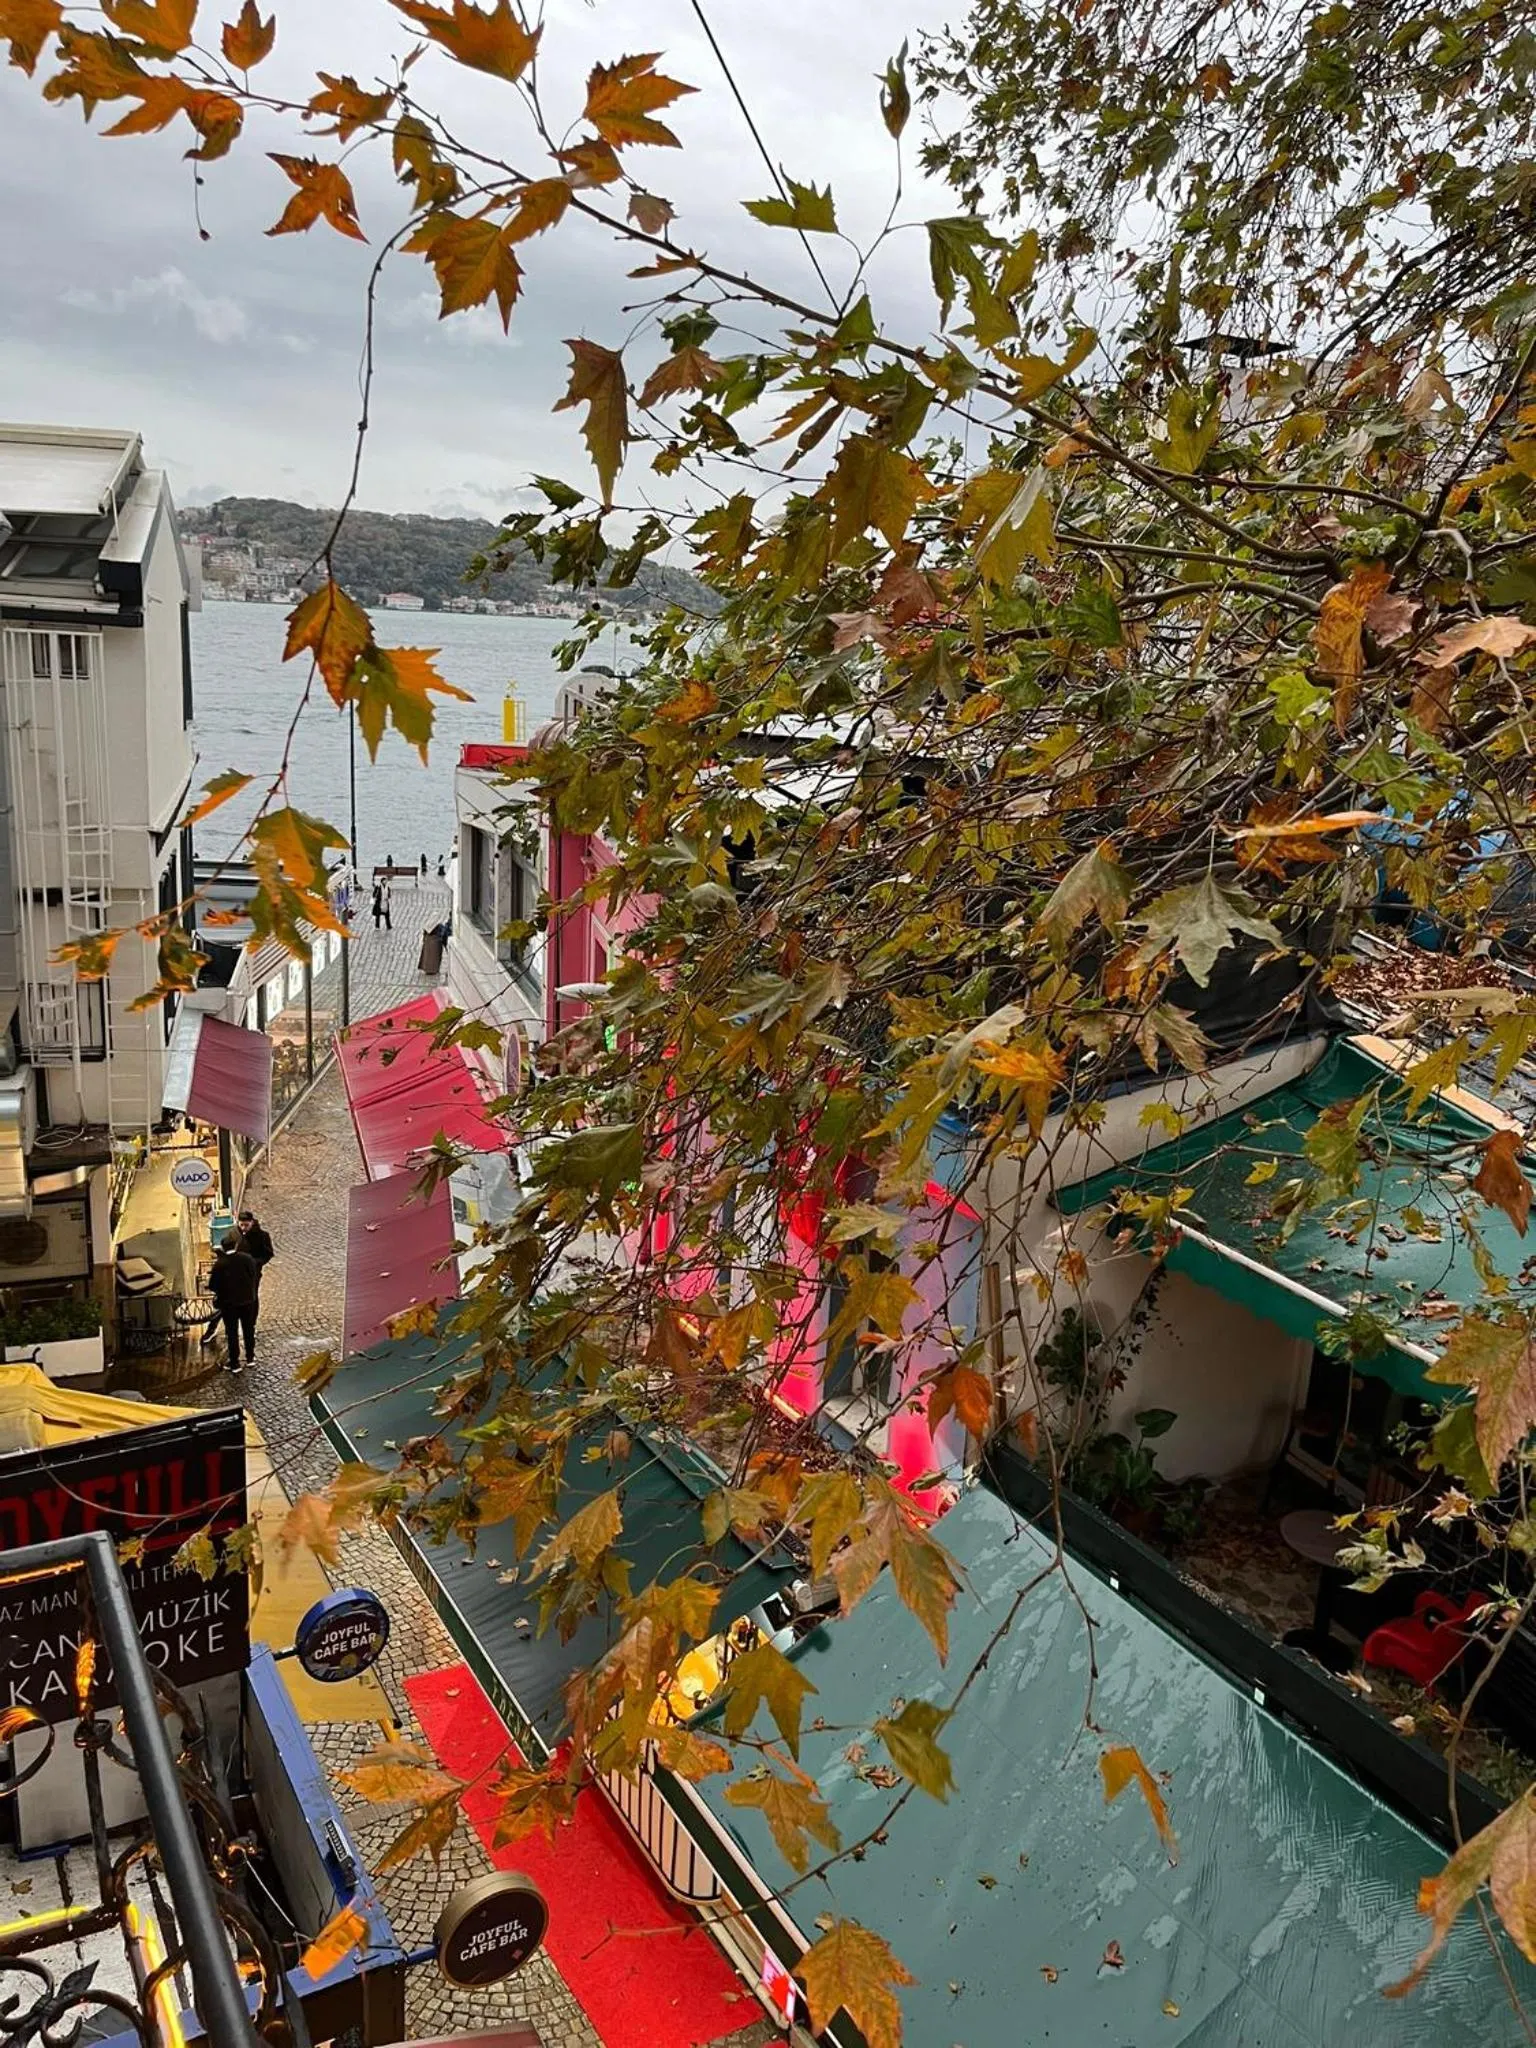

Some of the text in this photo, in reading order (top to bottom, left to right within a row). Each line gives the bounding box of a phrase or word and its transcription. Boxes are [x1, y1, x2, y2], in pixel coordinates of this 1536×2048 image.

[175, 1172, 210, 1184] MADO
[314, 1632, 377, 1660] CAFE BAR
[321, 1622, 371, 1645] JOYFUL
[9, 1622, 226, 1707] KAOKE
[460, 1927, 529, 1962] CAFE BAR
[468, 1920, 522, 1947] JOYFUL
